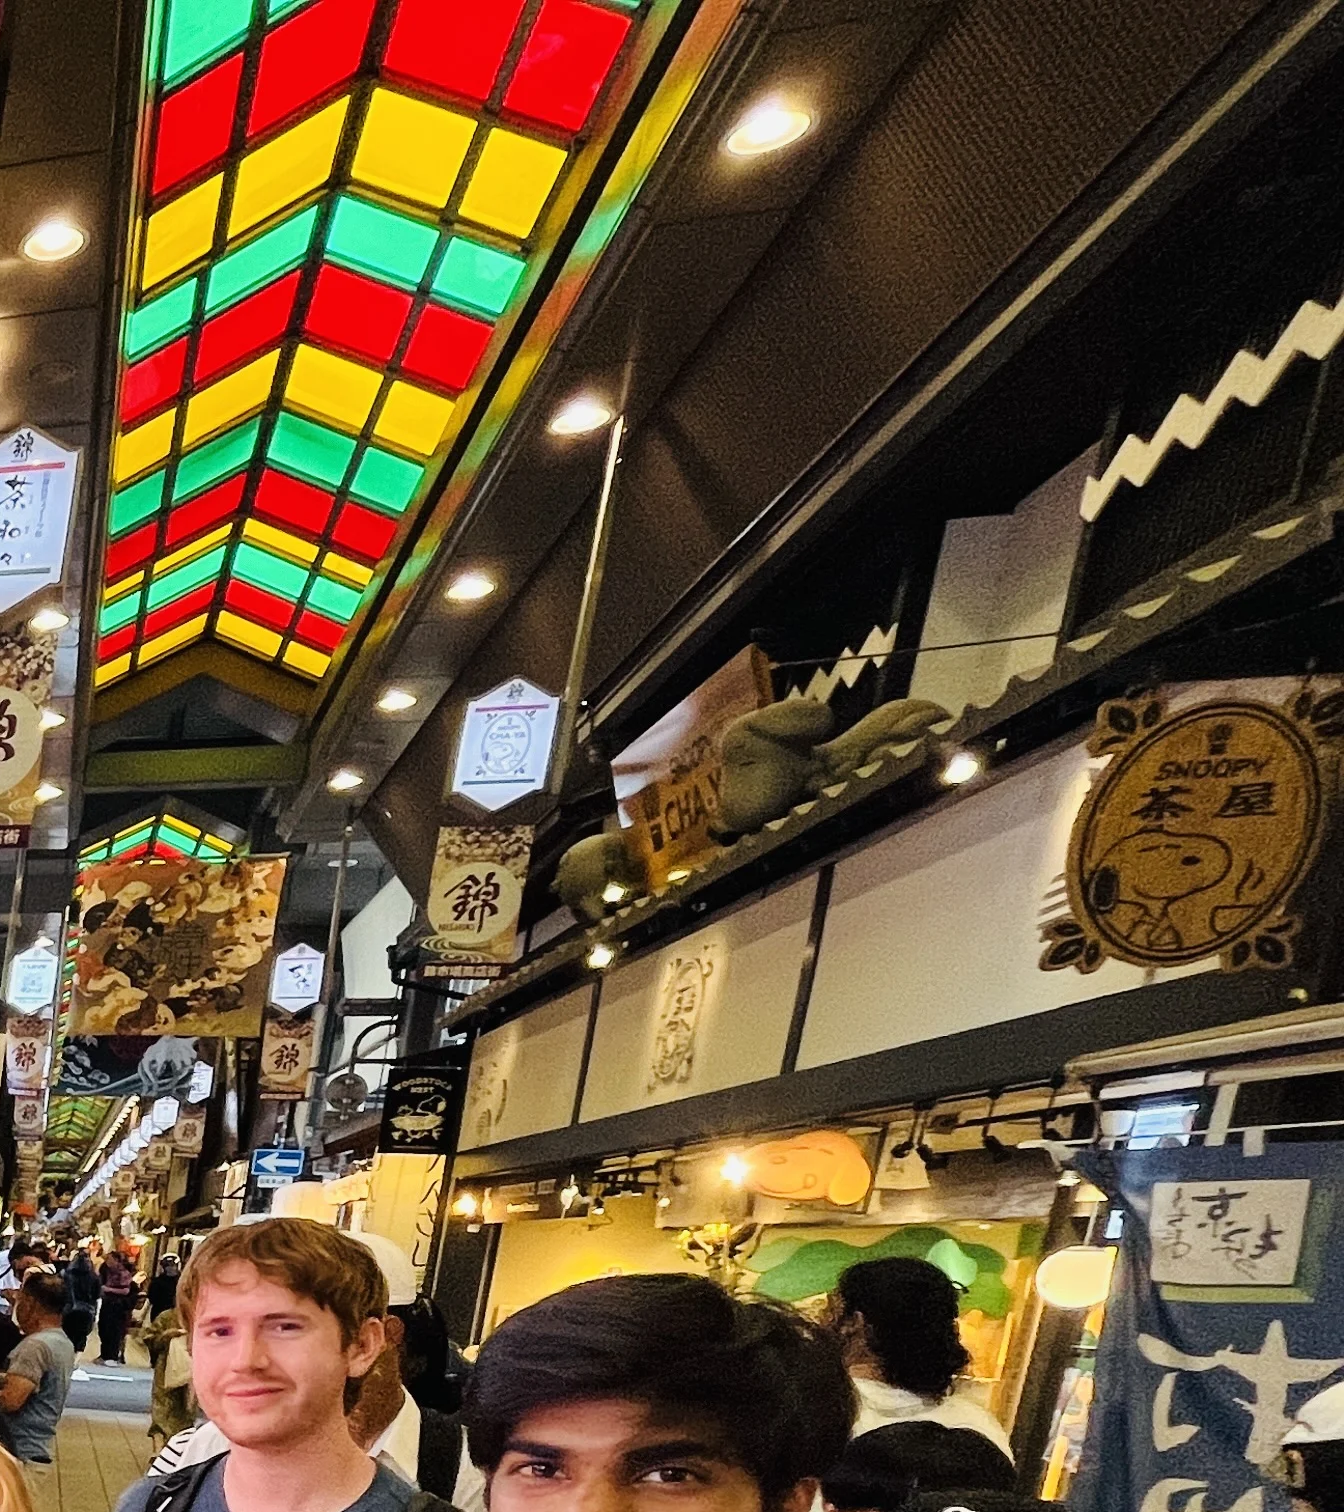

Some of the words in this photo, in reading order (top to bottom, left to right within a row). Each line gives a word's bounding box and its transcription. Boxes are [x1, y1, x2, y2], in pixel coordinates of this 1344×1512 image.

[1152, 755, 1270, 782] SNOOPY
[1132, 781, 1279, 832] 茶屋
[443, 871, 500, 934] 錦
[269, 1043, 300, 1074] 錦
